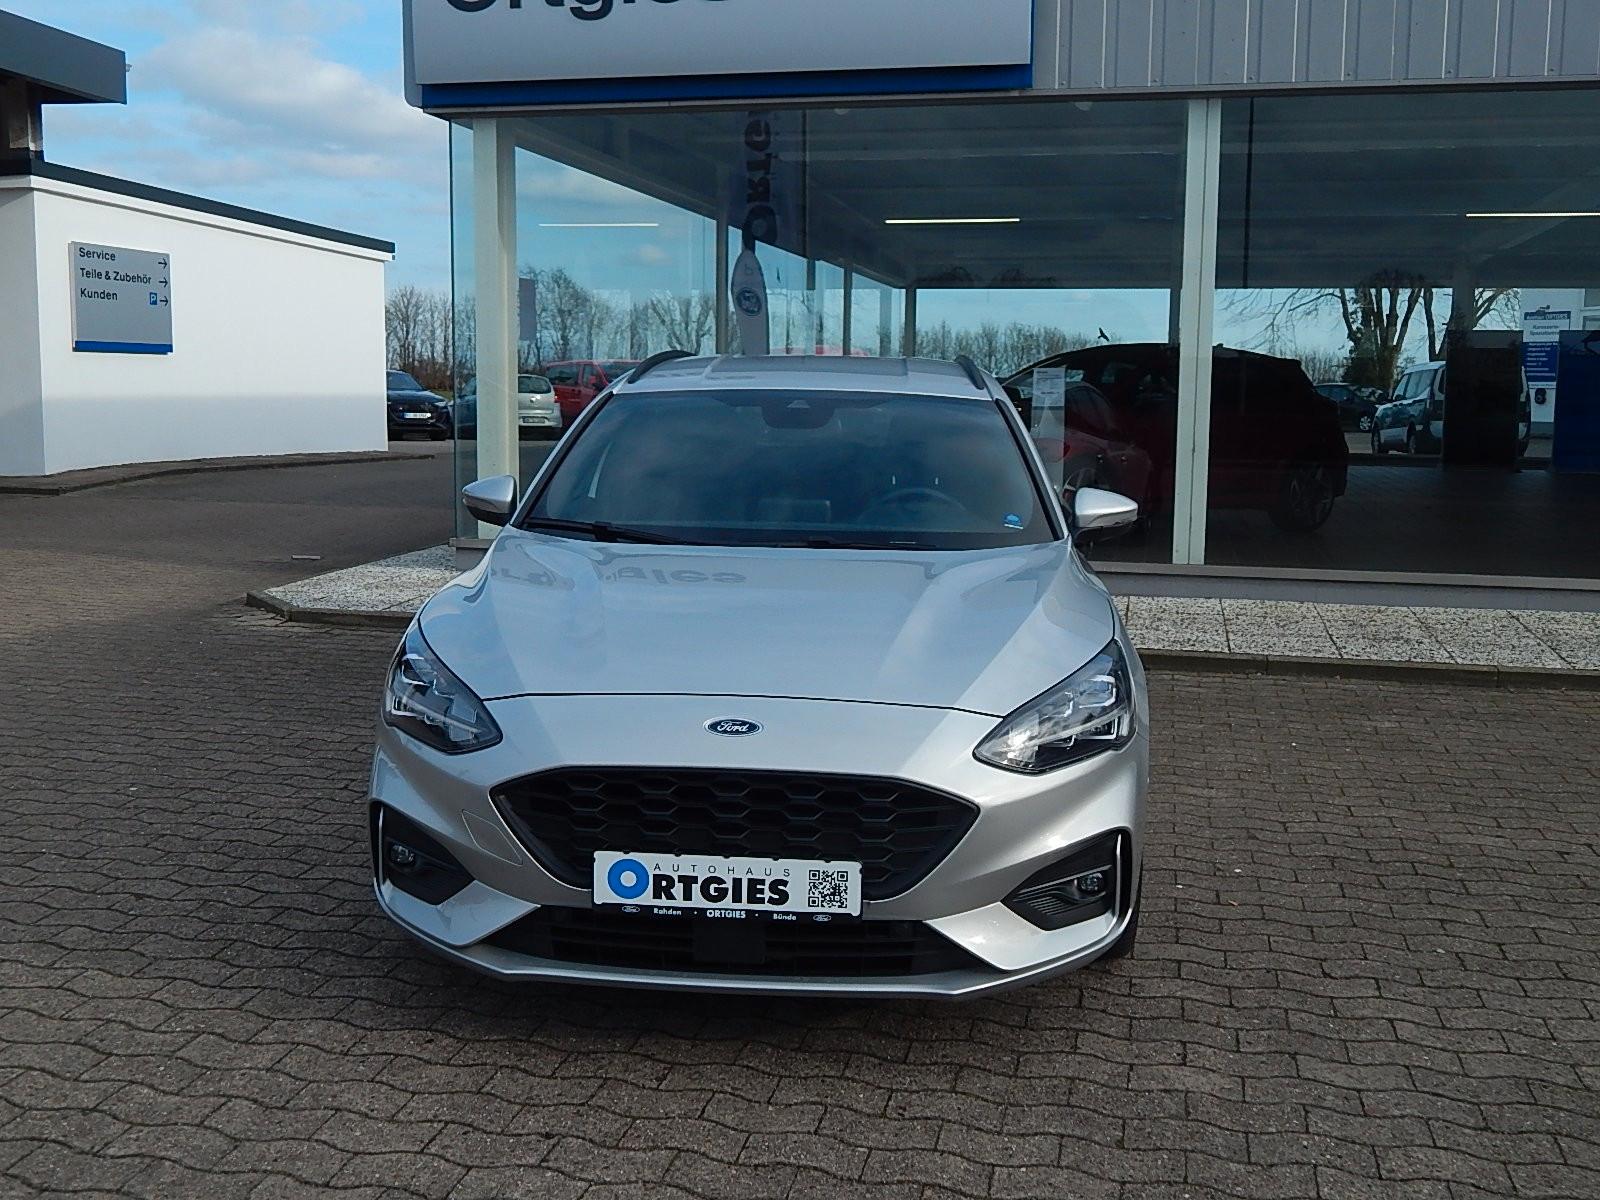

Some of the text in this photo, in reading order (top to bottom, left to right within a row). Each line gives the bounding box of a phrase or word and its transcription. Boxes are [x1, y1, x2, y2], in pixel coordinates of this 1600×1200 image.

[79, 247, 116, 261] Service
[80, 268, 152, 285] Teile & Zubehör
[80, 288, 118, 301] Kunden
[716, 720, 750, 732] Ford
[653, 863, 791, 878] AUTOHAUS
[607, 858, 790, 907] ORTGIES
[653, 907, 682, 916] Rahden
[706, 909, 747, 919] ORTGIES
